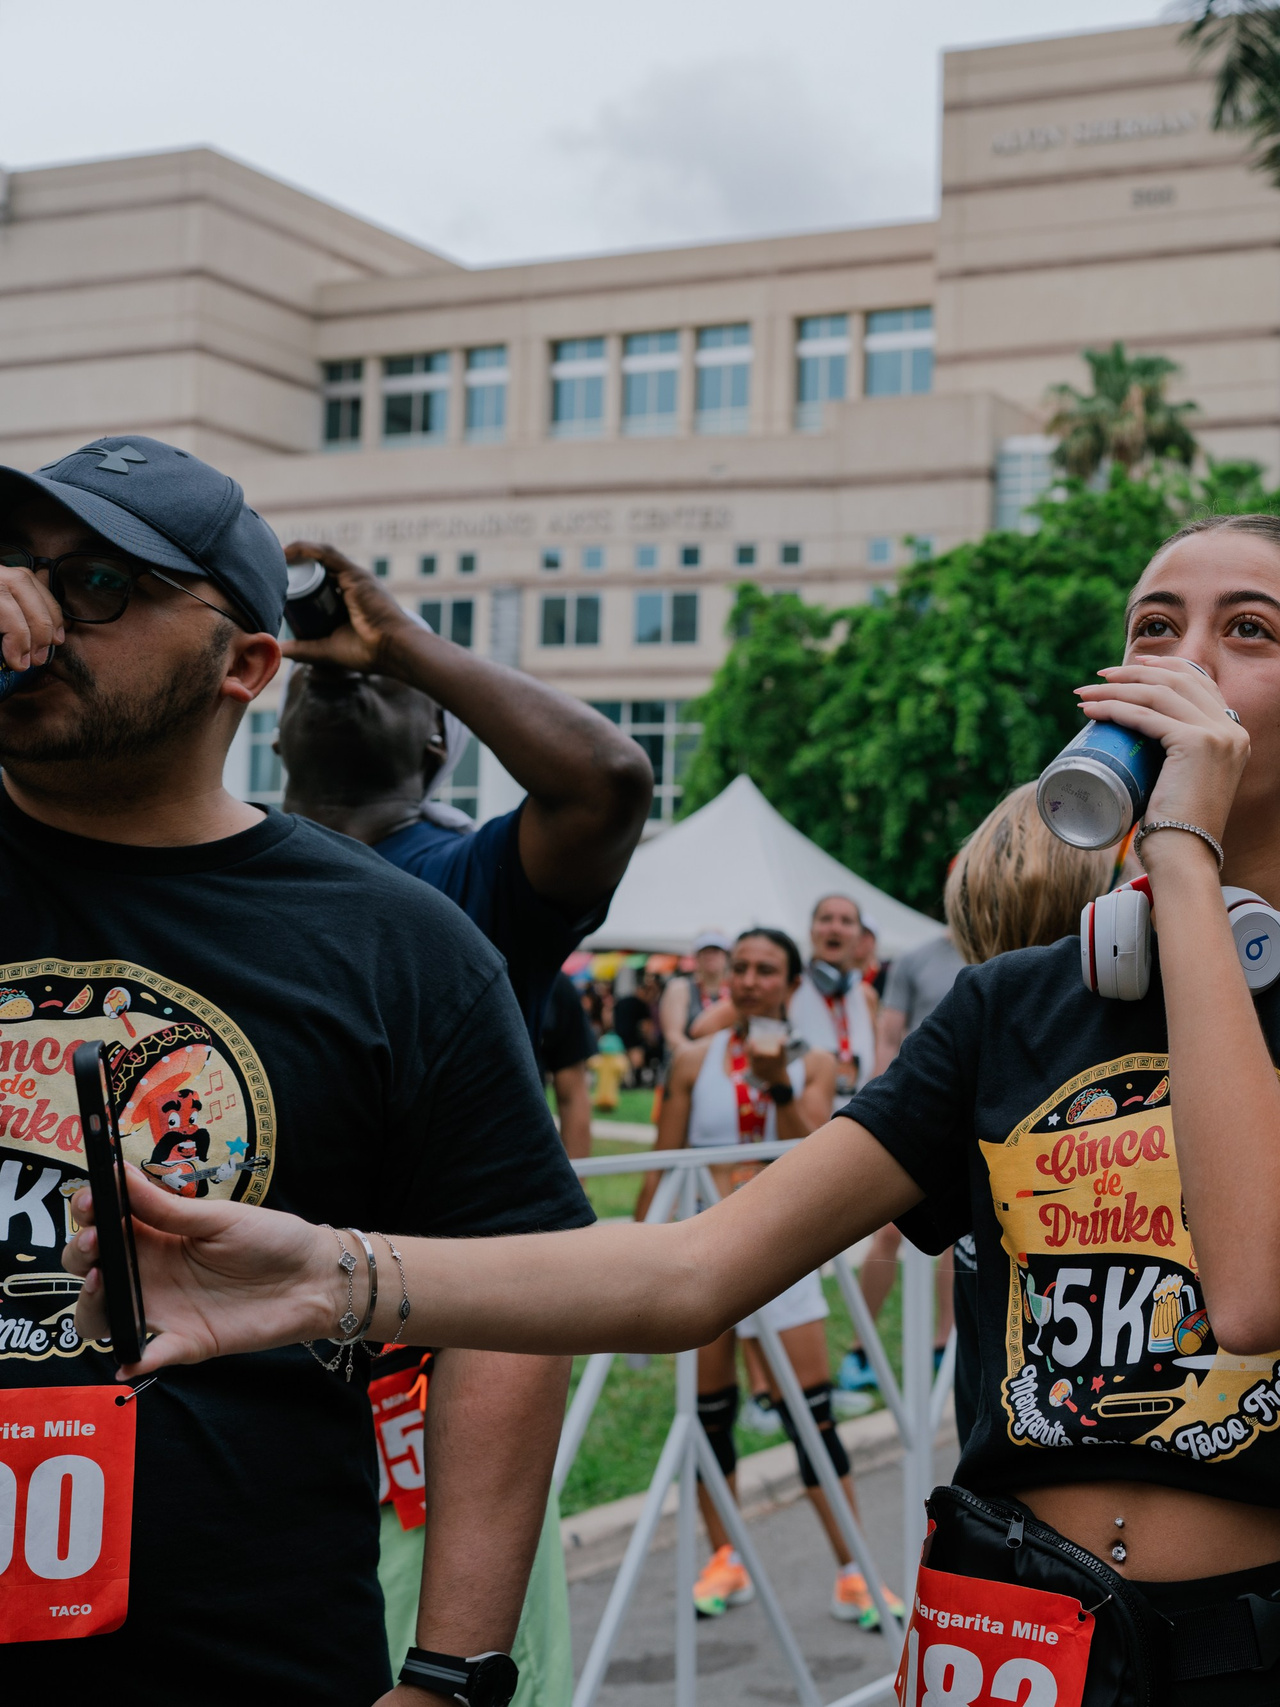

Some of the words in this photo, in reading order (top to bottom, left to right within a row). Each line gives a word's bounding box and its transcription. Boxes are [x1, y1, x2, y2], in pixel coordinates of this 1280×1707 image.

[1036, 1125, 1170, 1184] Cinco
[1093, 1170, 1124, 1197] de
[1038, 1191, 1177, 1248] Drinko
[1052, 1266, 1161, 1368] 5K
[43, 1420, 96, 1438] Mile
[1175, 1417, 1250, 1460] Taco
[49, 1603, 92, 1617] TACO
[1011, 1620, 1060, 1645] Mile
